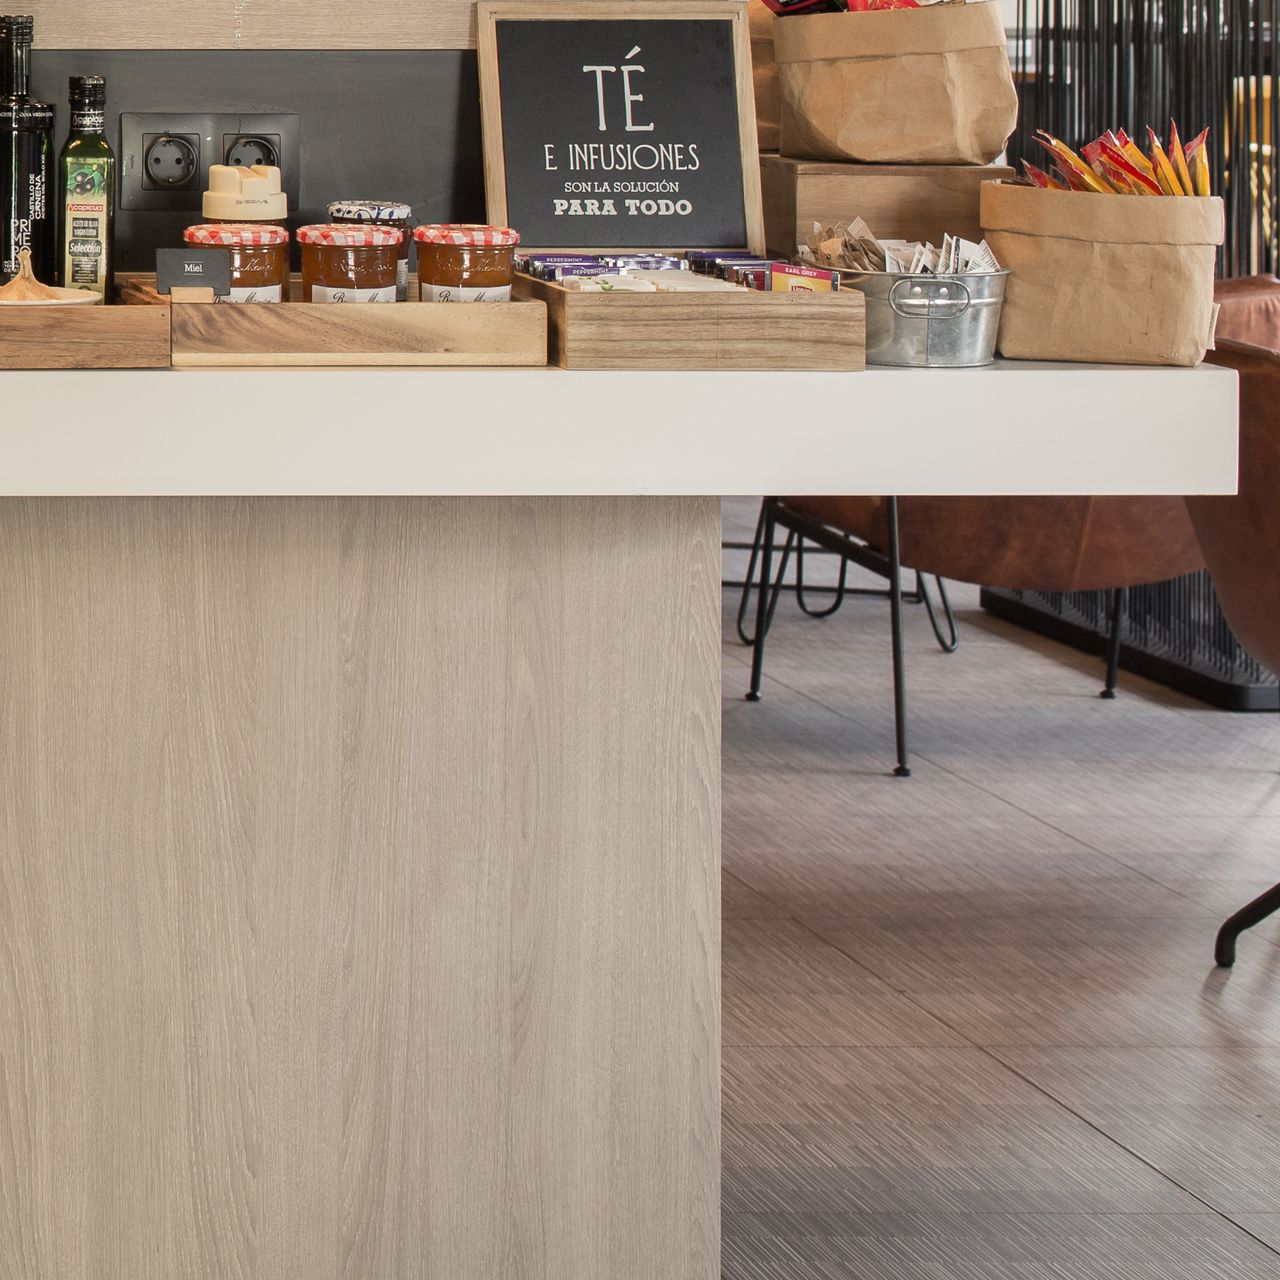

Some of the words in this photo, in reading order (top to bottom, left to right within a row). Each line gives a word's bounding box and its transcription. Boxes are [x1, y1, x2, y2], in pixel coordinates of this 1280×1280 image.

[582, 45, 655, 131] TÉ
[544, 144, 558, 170] E
[569, 144, 700, 170] INFUSIONES
[29, 173, 35, 184] DE
[564, 182, 594, 193] SON
[595, 182, 611, 193] LA
[614, 179, 679, 193] SOLUCIÓN
[553, 199, 618, 216] PARA
[625, 199, 692, 216] TODO
[70, 242, 101, 253] Selección
[184, 264, 202, 272] Miel
[785, 267, 800, 275] EARL
